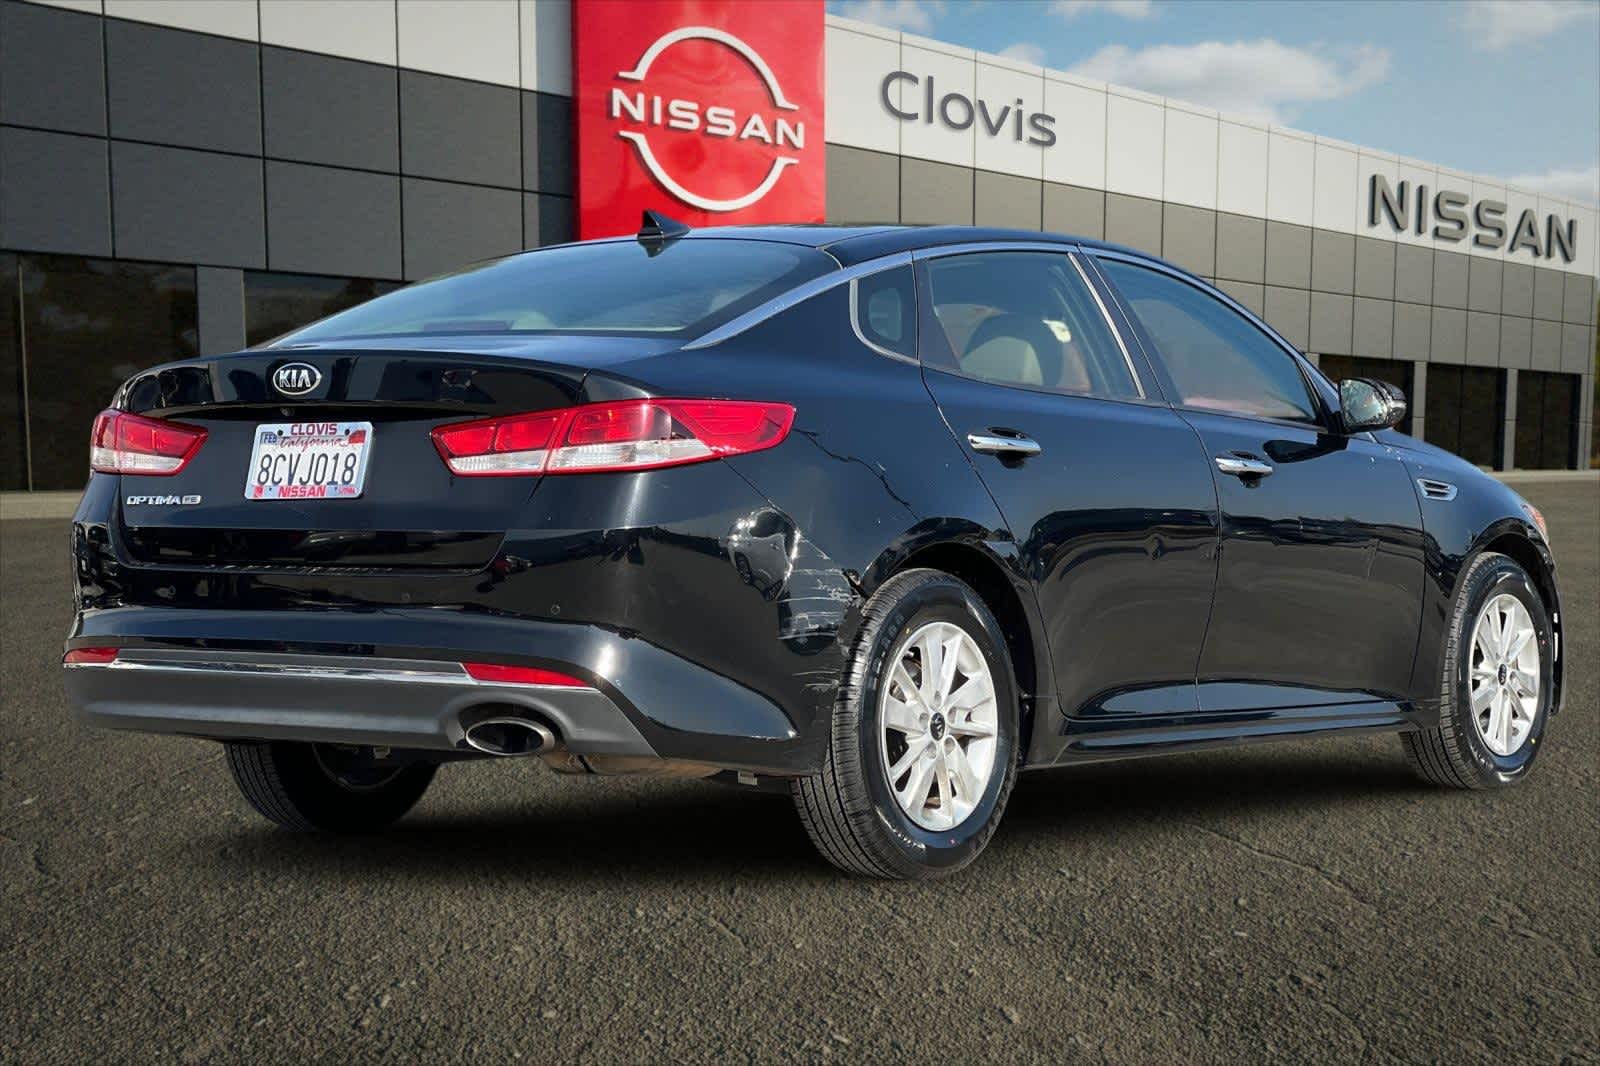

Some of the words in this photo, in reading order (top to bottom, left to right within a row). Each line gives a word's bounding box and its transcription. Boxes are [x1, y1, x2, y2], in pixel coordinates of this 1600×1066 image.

[881, 70, 1057, 147] Clovis
[610, 88, 805, 149] NISSAN
[1368, 173, 1578, 263] NISSAN
[279, 369, 311, 388] KIA
[290, 423, 338, 436] CLOVIS
[279, 436, 346, 452] California
[257, 452, 357, 486] 8CVJ018
[126, 495, 181, 505] OPTIMA
[278, 486, 327, 498] NISSAN
